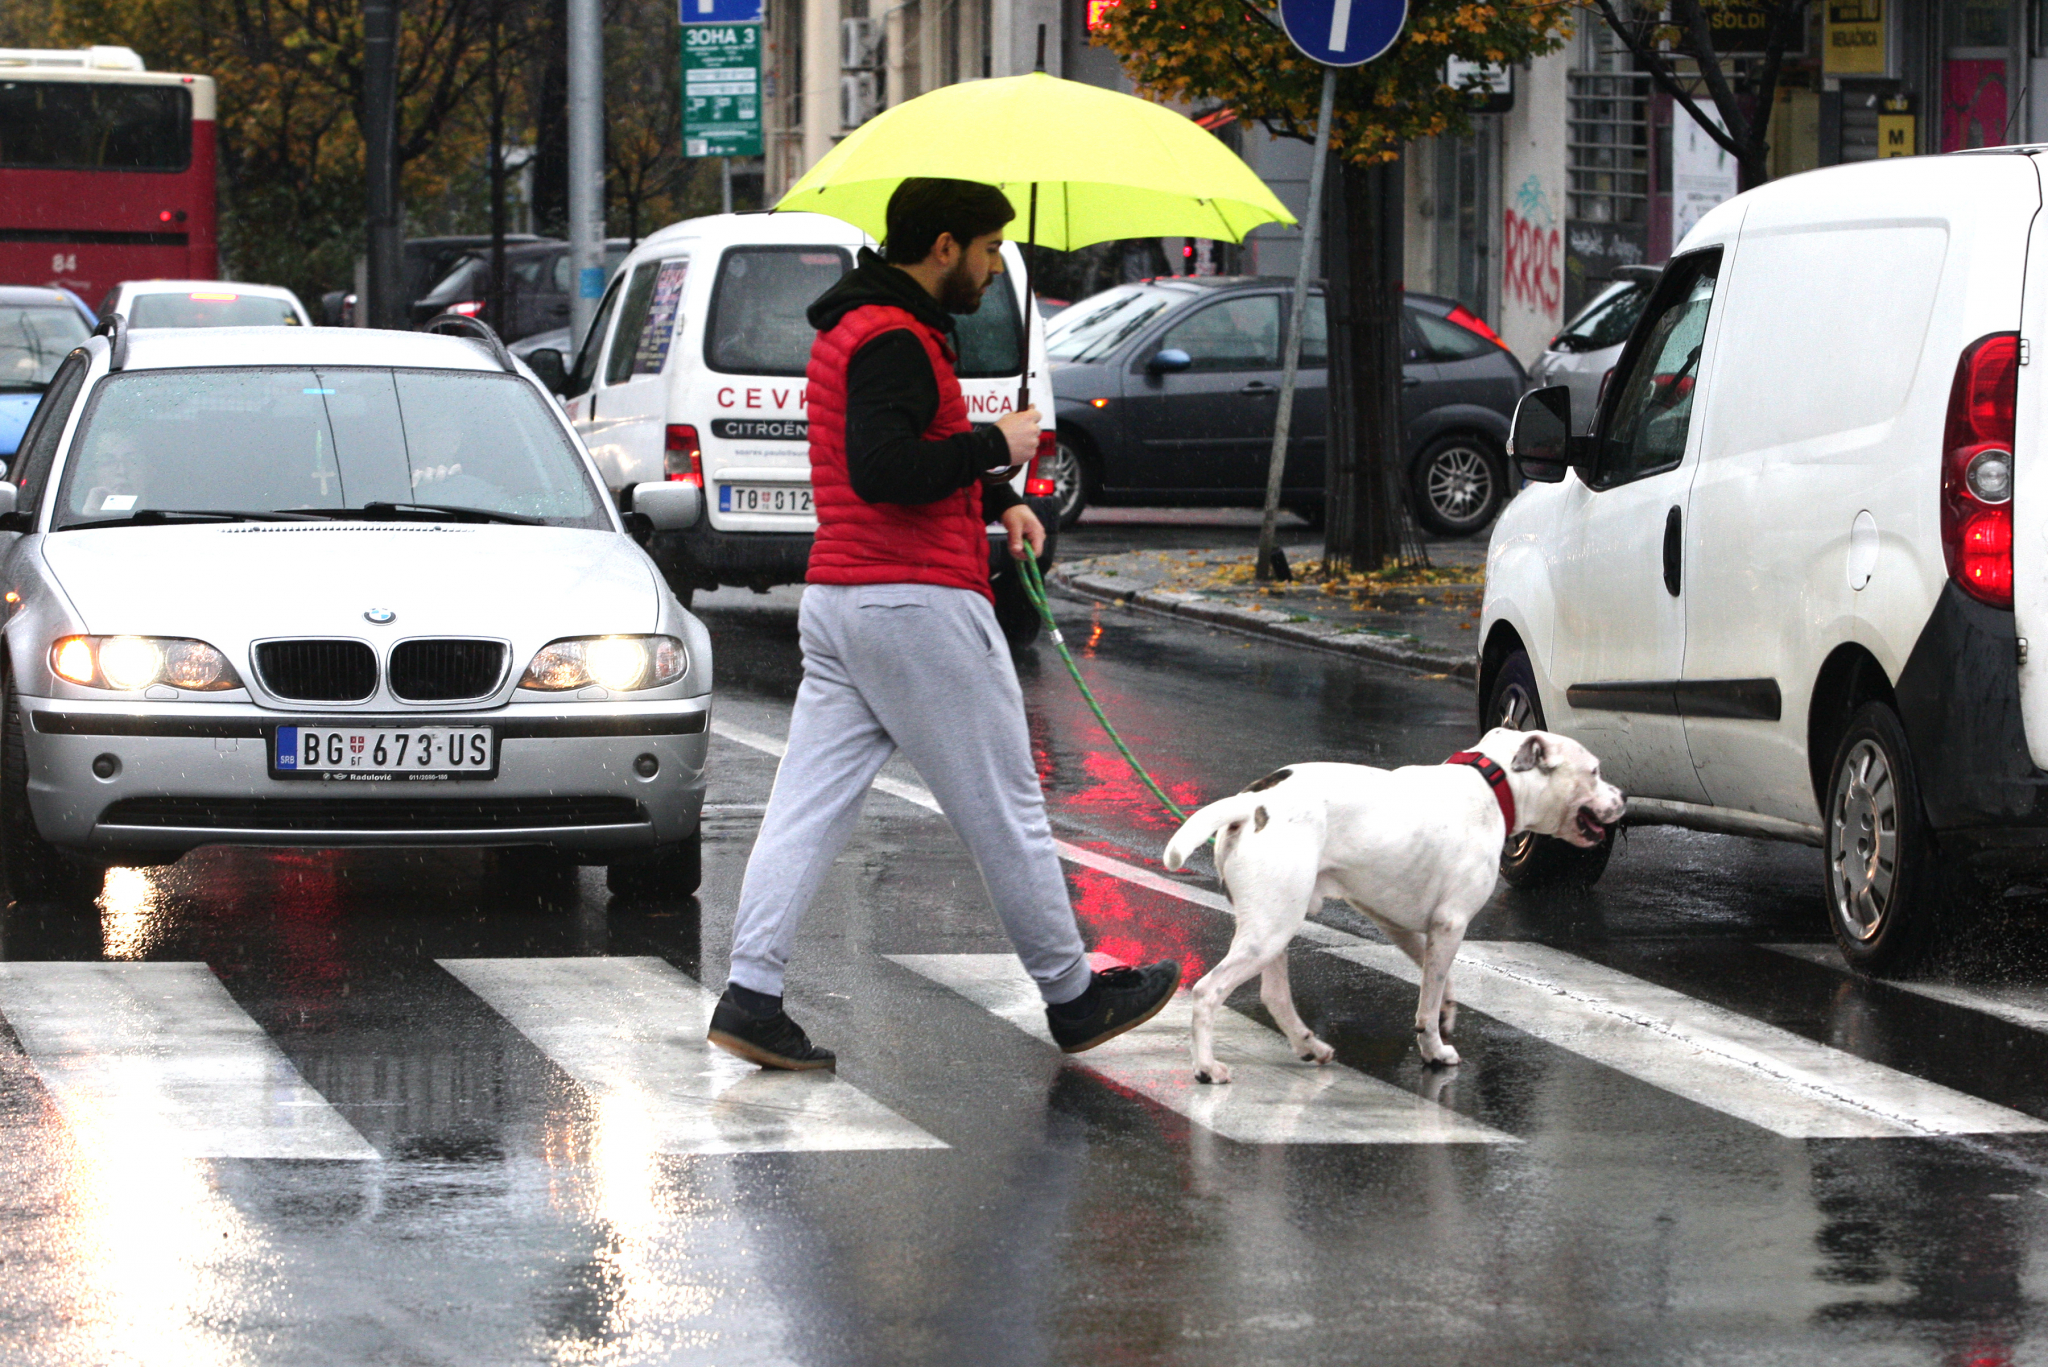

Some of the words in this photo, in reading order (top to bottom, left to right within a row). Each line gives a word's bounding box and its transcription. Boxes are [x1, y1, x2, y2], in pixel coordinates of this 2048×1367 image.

[1712, 12, 1766, 29] SOLDI
[686, 28, 737, 45] ЗОНА
[743, 28, 755, 43] 3
[52, 253, 77, 273] 84
[963, 390, 1013, 414] INČA
[725, 421, 808, 436] CITROËN
[304, 733, 343, 766] BG
[280, 755, 295, 765] SRB
[350, 773, 392, 781] Radulović
